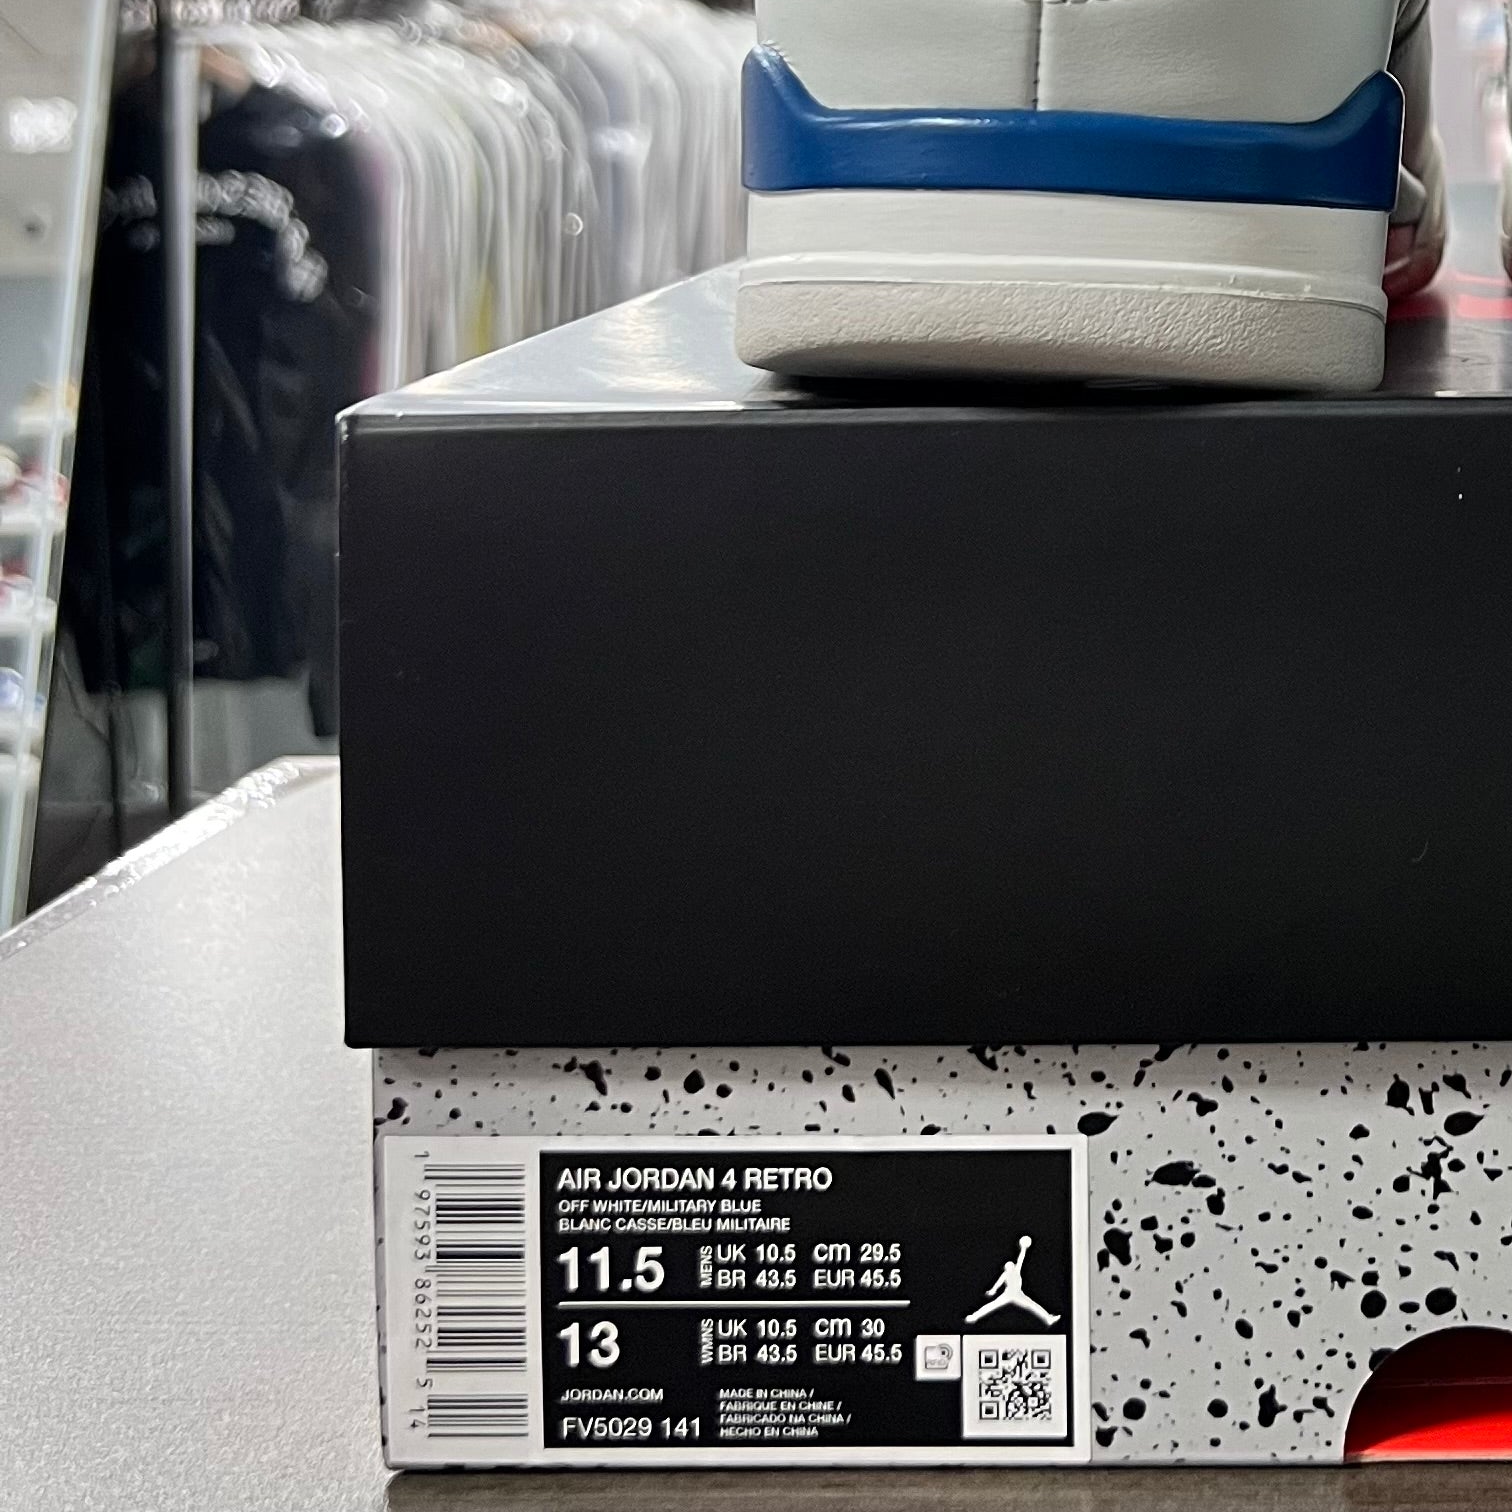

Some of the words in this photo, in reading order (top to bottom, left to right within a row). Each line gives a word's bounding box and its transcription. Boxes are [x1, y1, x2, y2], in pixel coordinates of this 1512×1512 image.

[557, 1167, 601, 1191] AIR
[608, 1167, 714, 1191] JORDAN
[720, 1167, 737, 1191] 4
[744, 1167, 833, 1191] RETRO
[558, 1199, 589, 1214] OFF
[592, 1199, 717, 1214] WHITE/MILITARY
[720, 1199, 762, 1213] BLUE
[414, 1189, 431, 1260] 97593
[559, 1218, 612, 1232] BLANC
[615, 1218, 713, 1232] CASSE/BLEU
[716, 1217, 791, 1231] MILITAIRE
[717, 1244, 746, 1263] UK
[755, 1243, 796, 1263] 10.5
[860, 1243, 901, 1263] 29.5
[557, 1246, 665, 1292] 11.5
[700, 1245, 713, 1288] MENS
[717, 1269, 746, 1288] BR
[755, 1269, 796, 1288] 43.5
[813, 1269, 855, 1288] EUR
[860, 1269, 901, 1287] 45.5
[414, 1278, 432, 1348] 86252
[717, 1319, 747, 1338] UK
[756, 1319, 797, 1338] 10.5
[861, 1318, 885, 1337] 30
[557, 1320, 620, 1368] 13
[700, 1318, 714, 1365] WMNS
[717, 1344, 747, 1364] BR
[756, 1344, 797, 1364] 43.5
[814, 1344, 856, 1363] EUR
[860, 1344, 902, 1363] 45.5
[561, 1388, 664, 1403] JORDAN.COM
[719, 1388, 754, 1399] MADE
[756, 1388, 768, 1399] IN
[770, 1388, 807, 1399] CHINA
[720, 1401, 777, 1412] FABRIQUE
[780, 1401, 796, 1411] EN
[798, 1401, 834, 1411] CHINE
[562, 1416, 652, 1438] FV5029
[660, 1416, 700, 1438] 141
[720, 1414, 786, 1424] FABRICADO
[789, 1414, 805, 1424] NA
[808, 1414, 844, 1424] CHINA
[720, 1426, 761, 1437] HECHO
[764, 1426, 780, 1437] EN
[783, 1426, 818, 1437] CHINA
